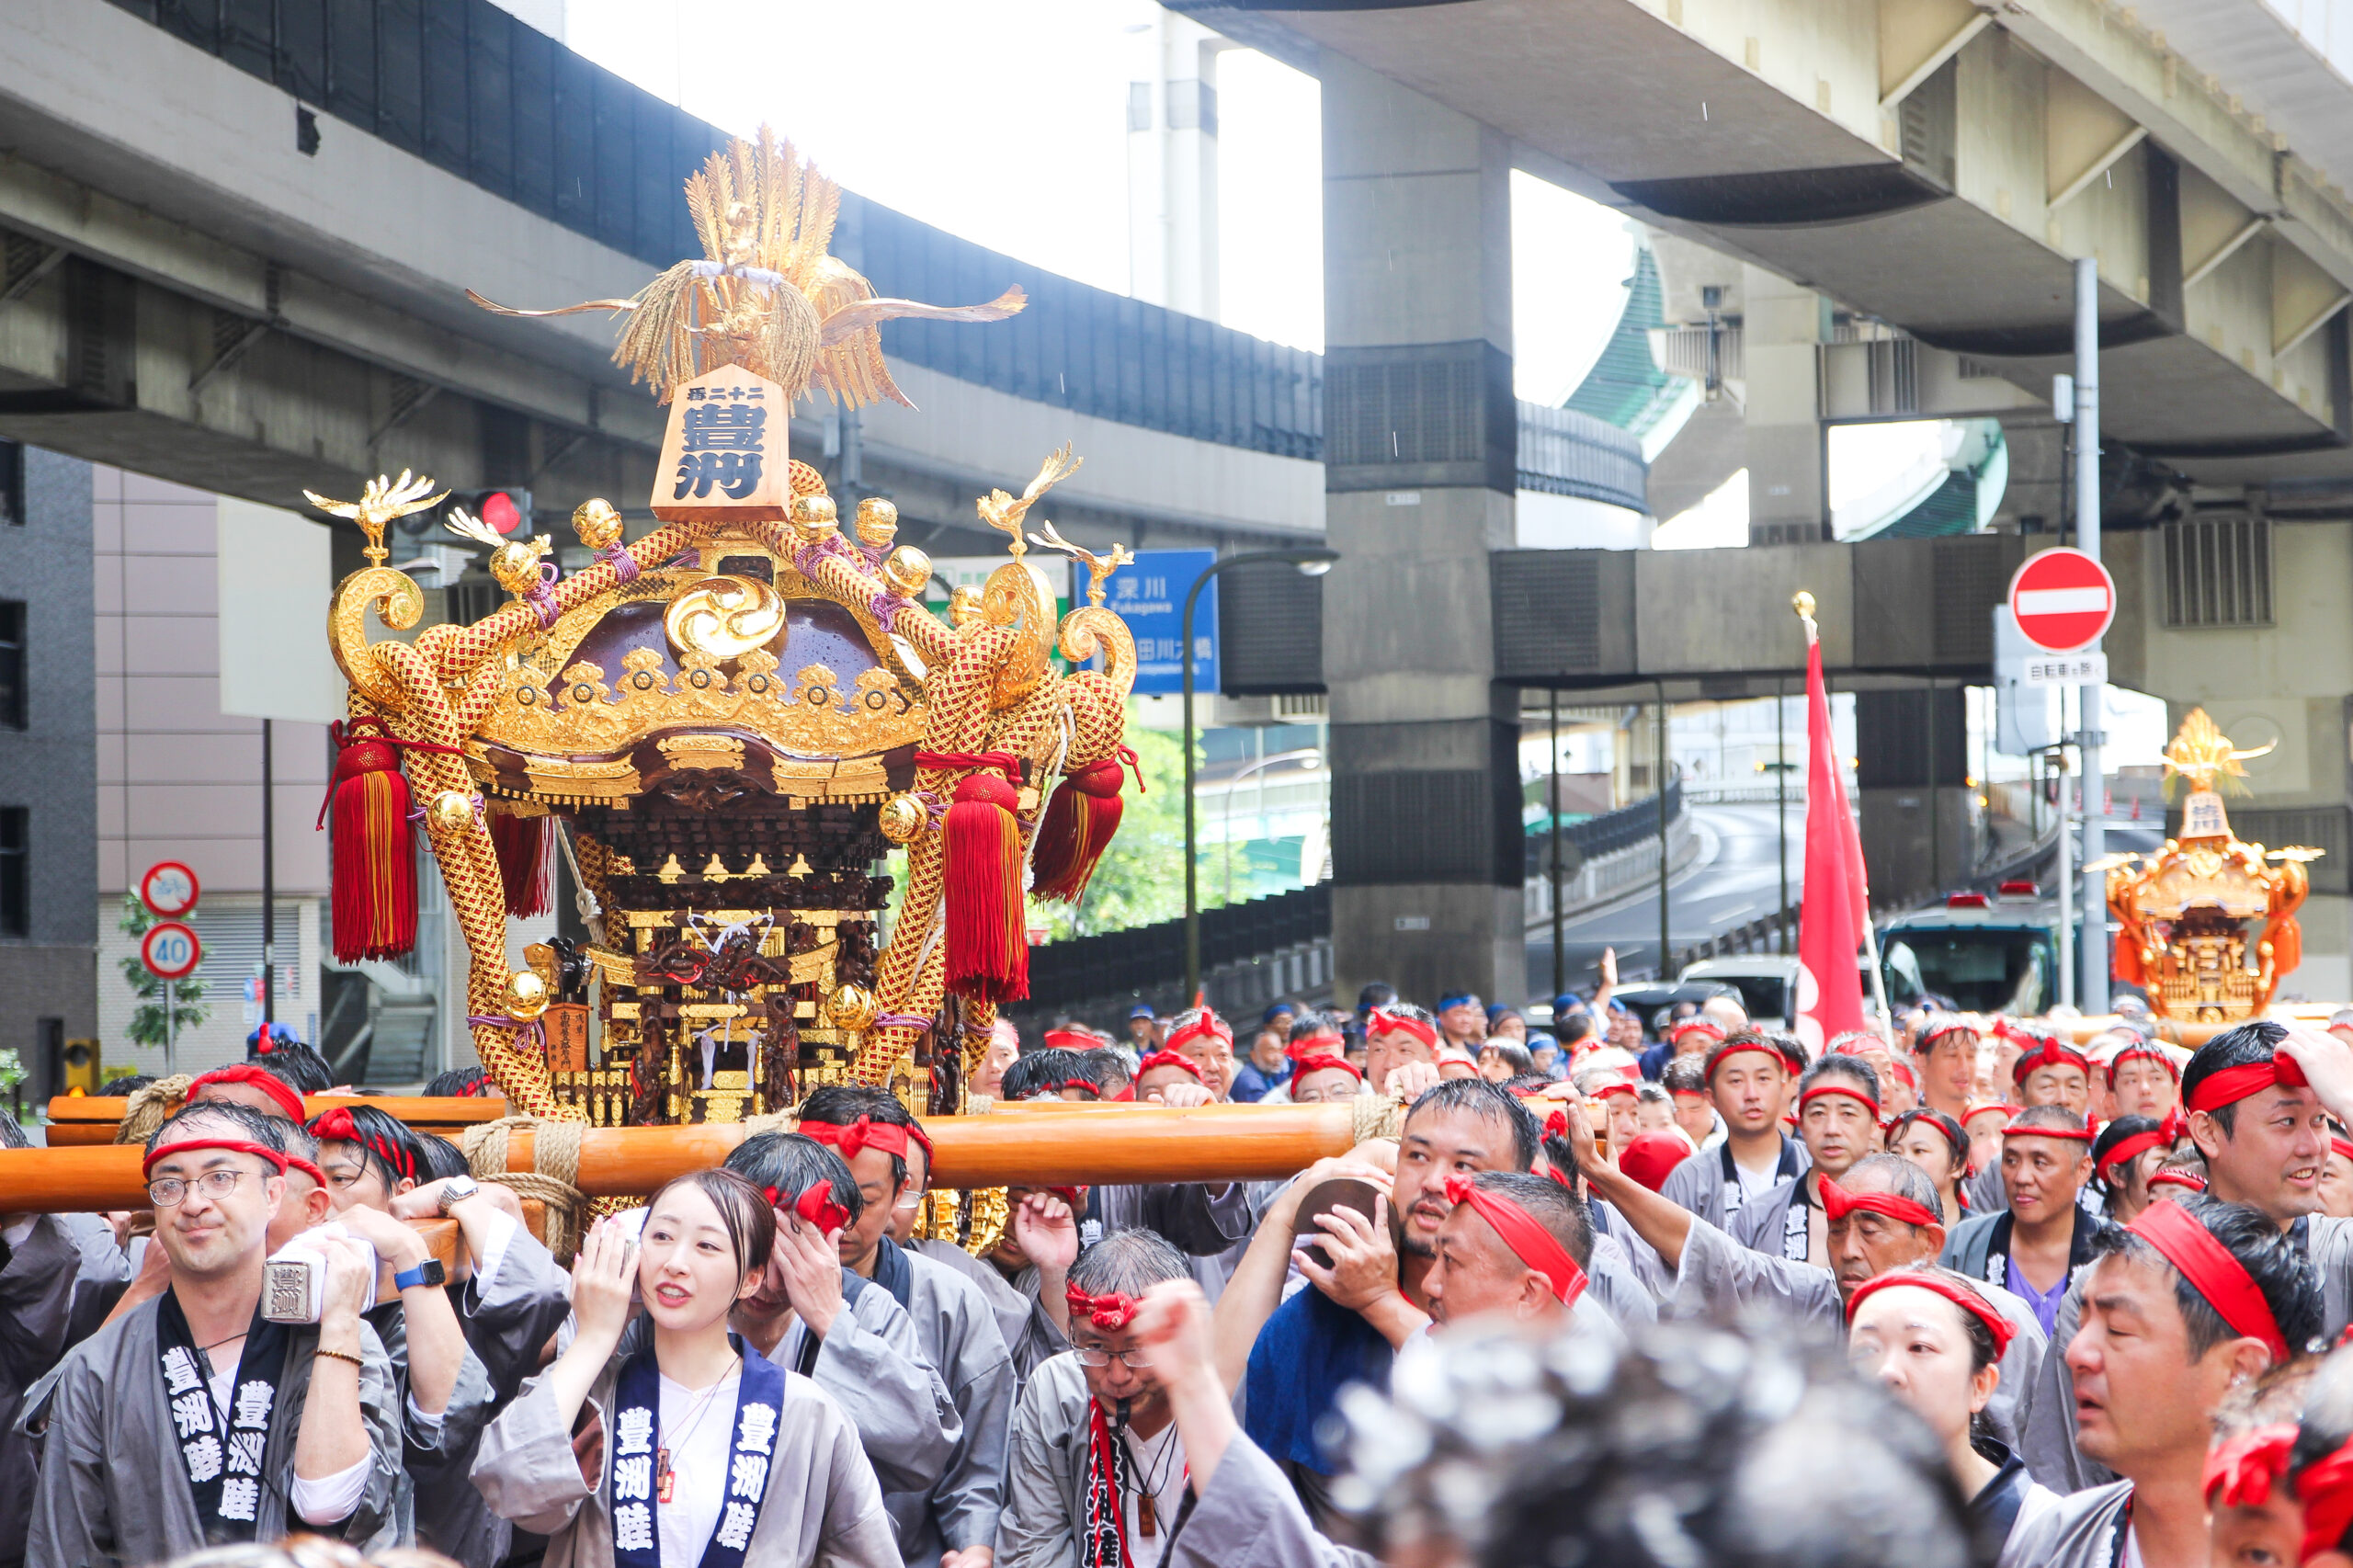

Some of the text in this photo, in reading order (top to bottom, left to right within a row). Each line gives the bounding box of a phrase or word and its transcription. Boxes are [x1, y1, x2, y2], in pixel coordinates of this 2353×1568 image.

[1116, 576, 1166, 599] 深川
[1110, 602, 1173, 616] Fukagawa
[154, 937, 188, 963] 40
[614, 1406, 654, 1551] 豊洲睦
[716, 1402, 778, 1552] 豊洲睦
